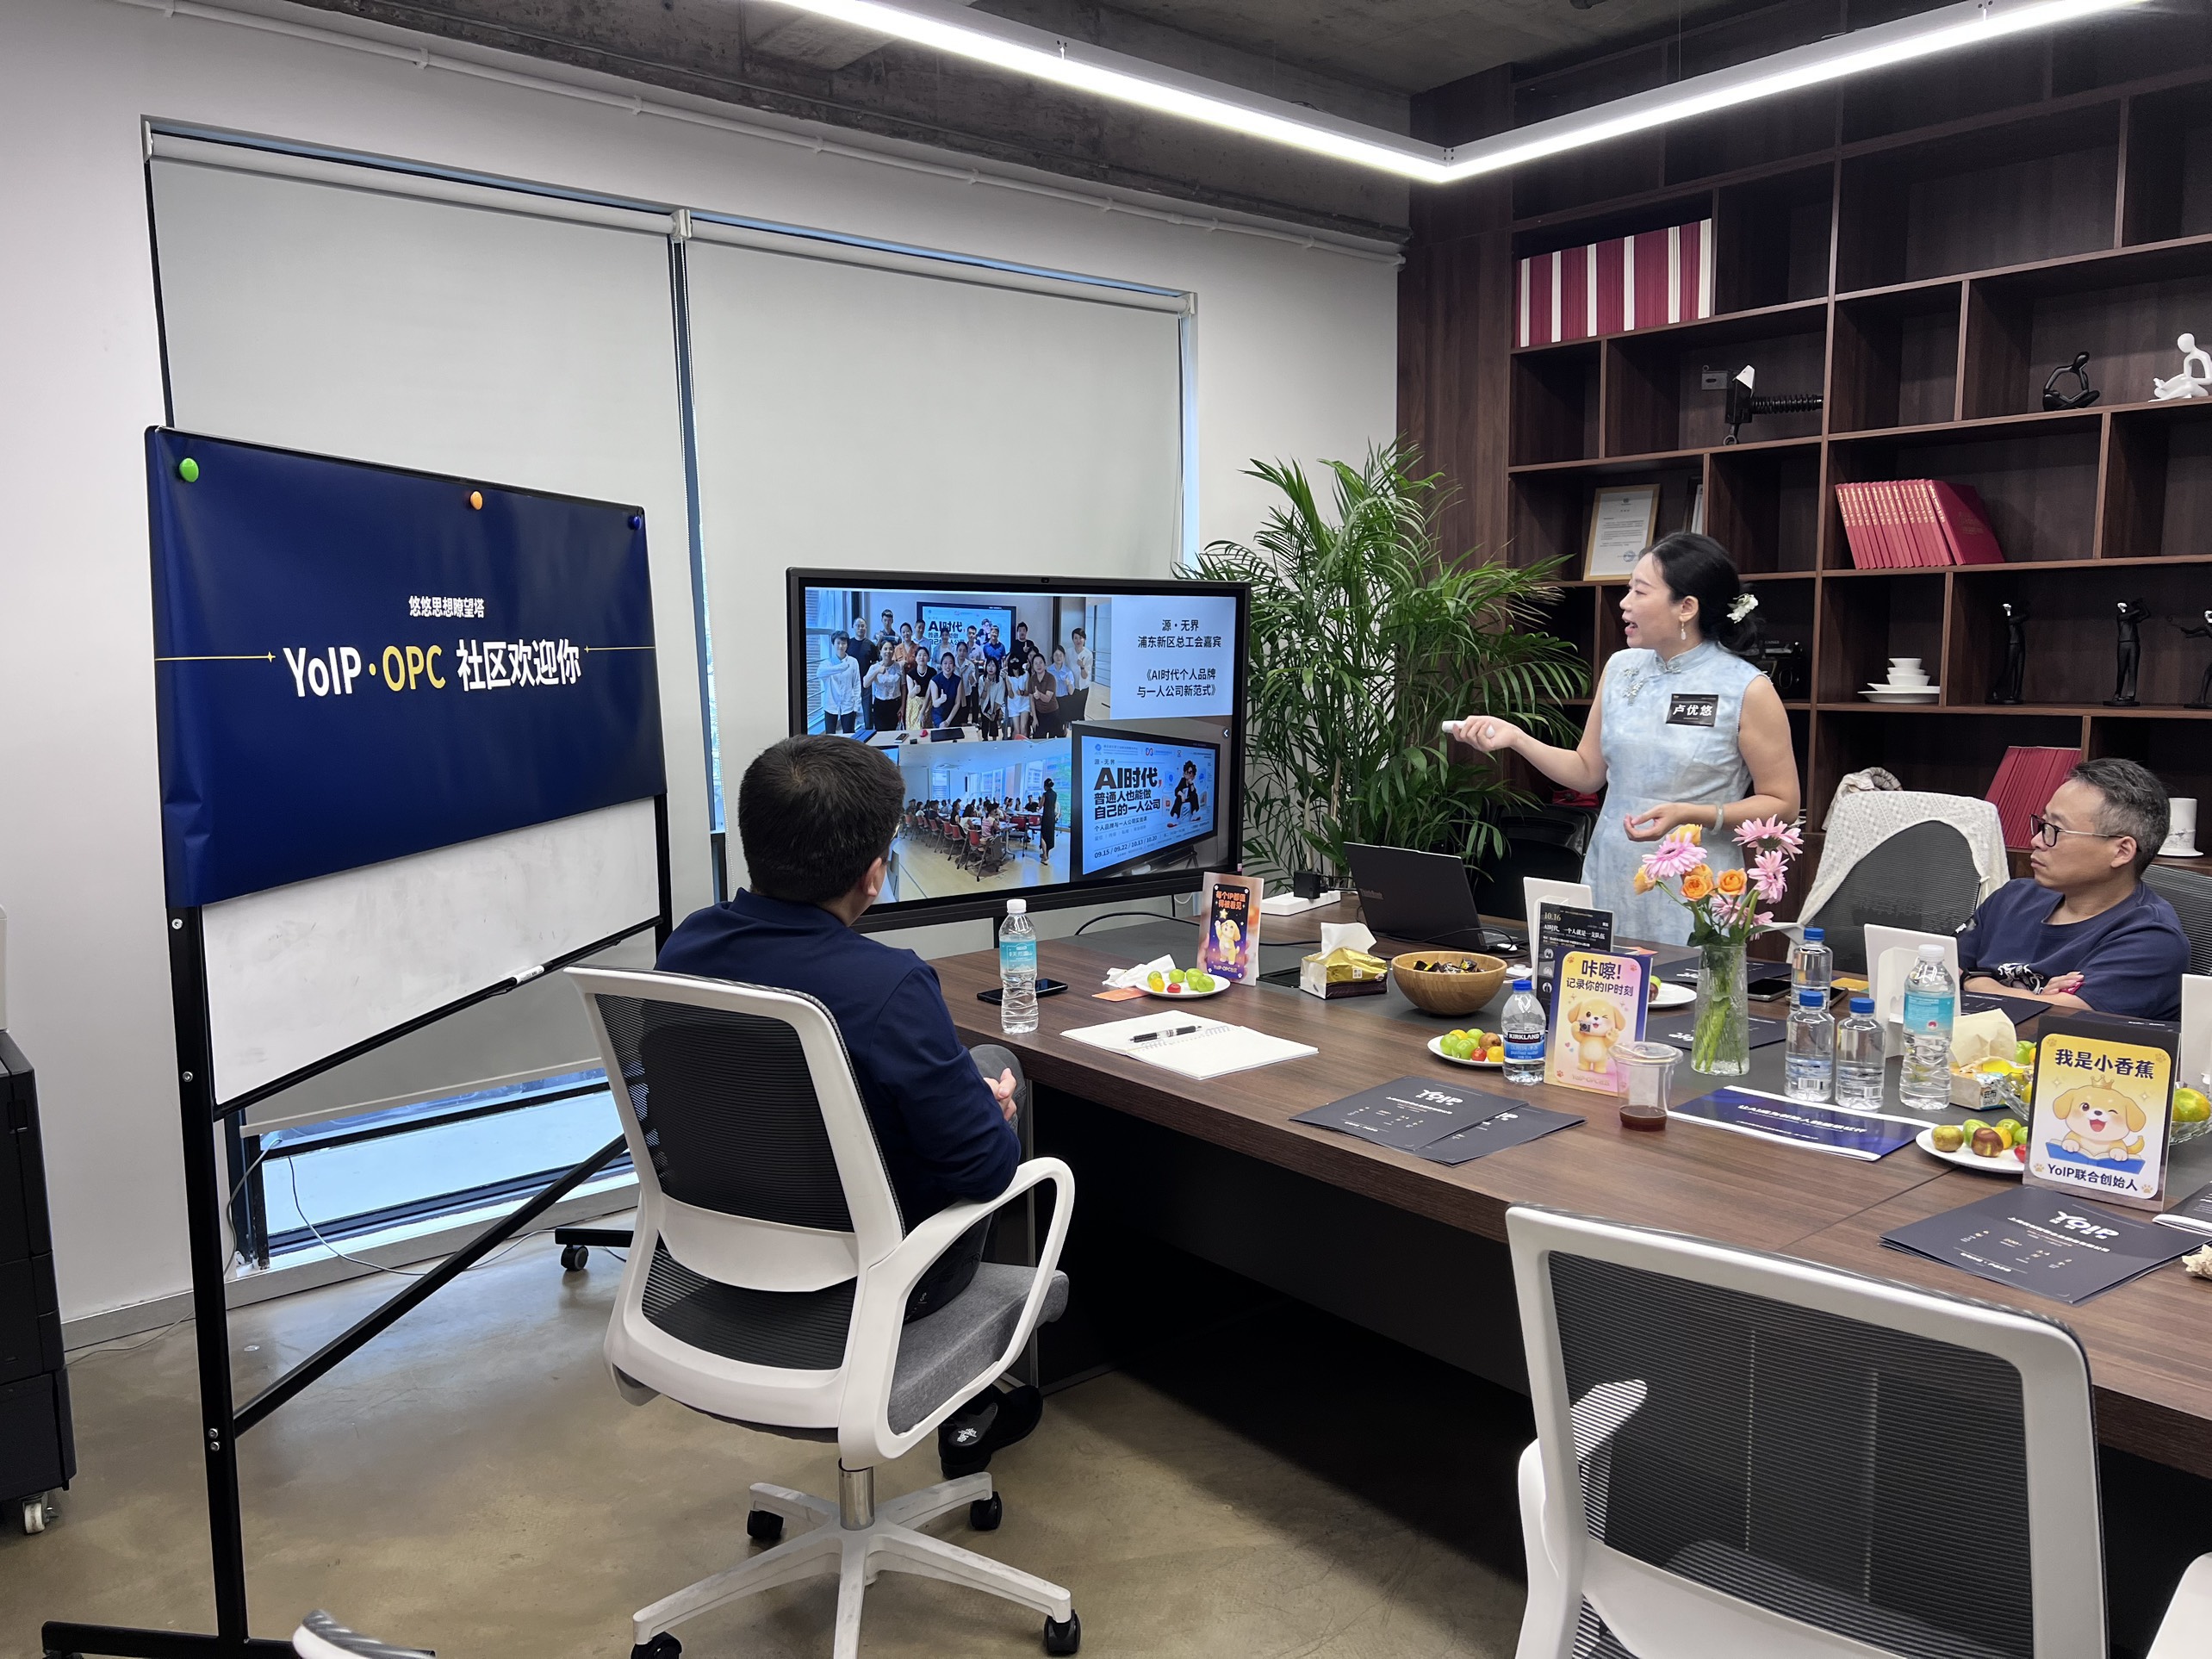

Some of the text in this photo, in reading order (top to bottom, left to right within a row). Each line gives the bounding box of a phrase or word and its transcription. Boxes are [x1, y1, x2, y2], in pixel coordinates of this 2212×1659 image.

[408, 595, 485, 618] 悠悠思想瞭望塔
[1161, 619, 1199, 631] 源·无界
[1137, 636, 1221, 648] 浦东新区总工会嘉宾
[456, 639, 581, 692] 社区欢迎你
[1146, 668, 1216, 681] 《AI时代个人品牌
[1137, 684, 1216, 698] 与一人公司新范式》
[1094, 788, 1152, 805] 普通人也能做
[1094, 798, 1161, 820] 自己的一人公司
[1094, 849, 1109, 859] 09.15
[1114, 844, 1128, 853] 09.22
[1544, 912, 1561, 922] 10.16
[1581, 960, 1621, 979] 咔嚓！
[1566, 978, 1633, 997] 记录你的IP时刻
[2054, 1048, 2155, 1079] 我是小香蕉
[2047, 1163, 2139, 1191] YoIP联合创始人
